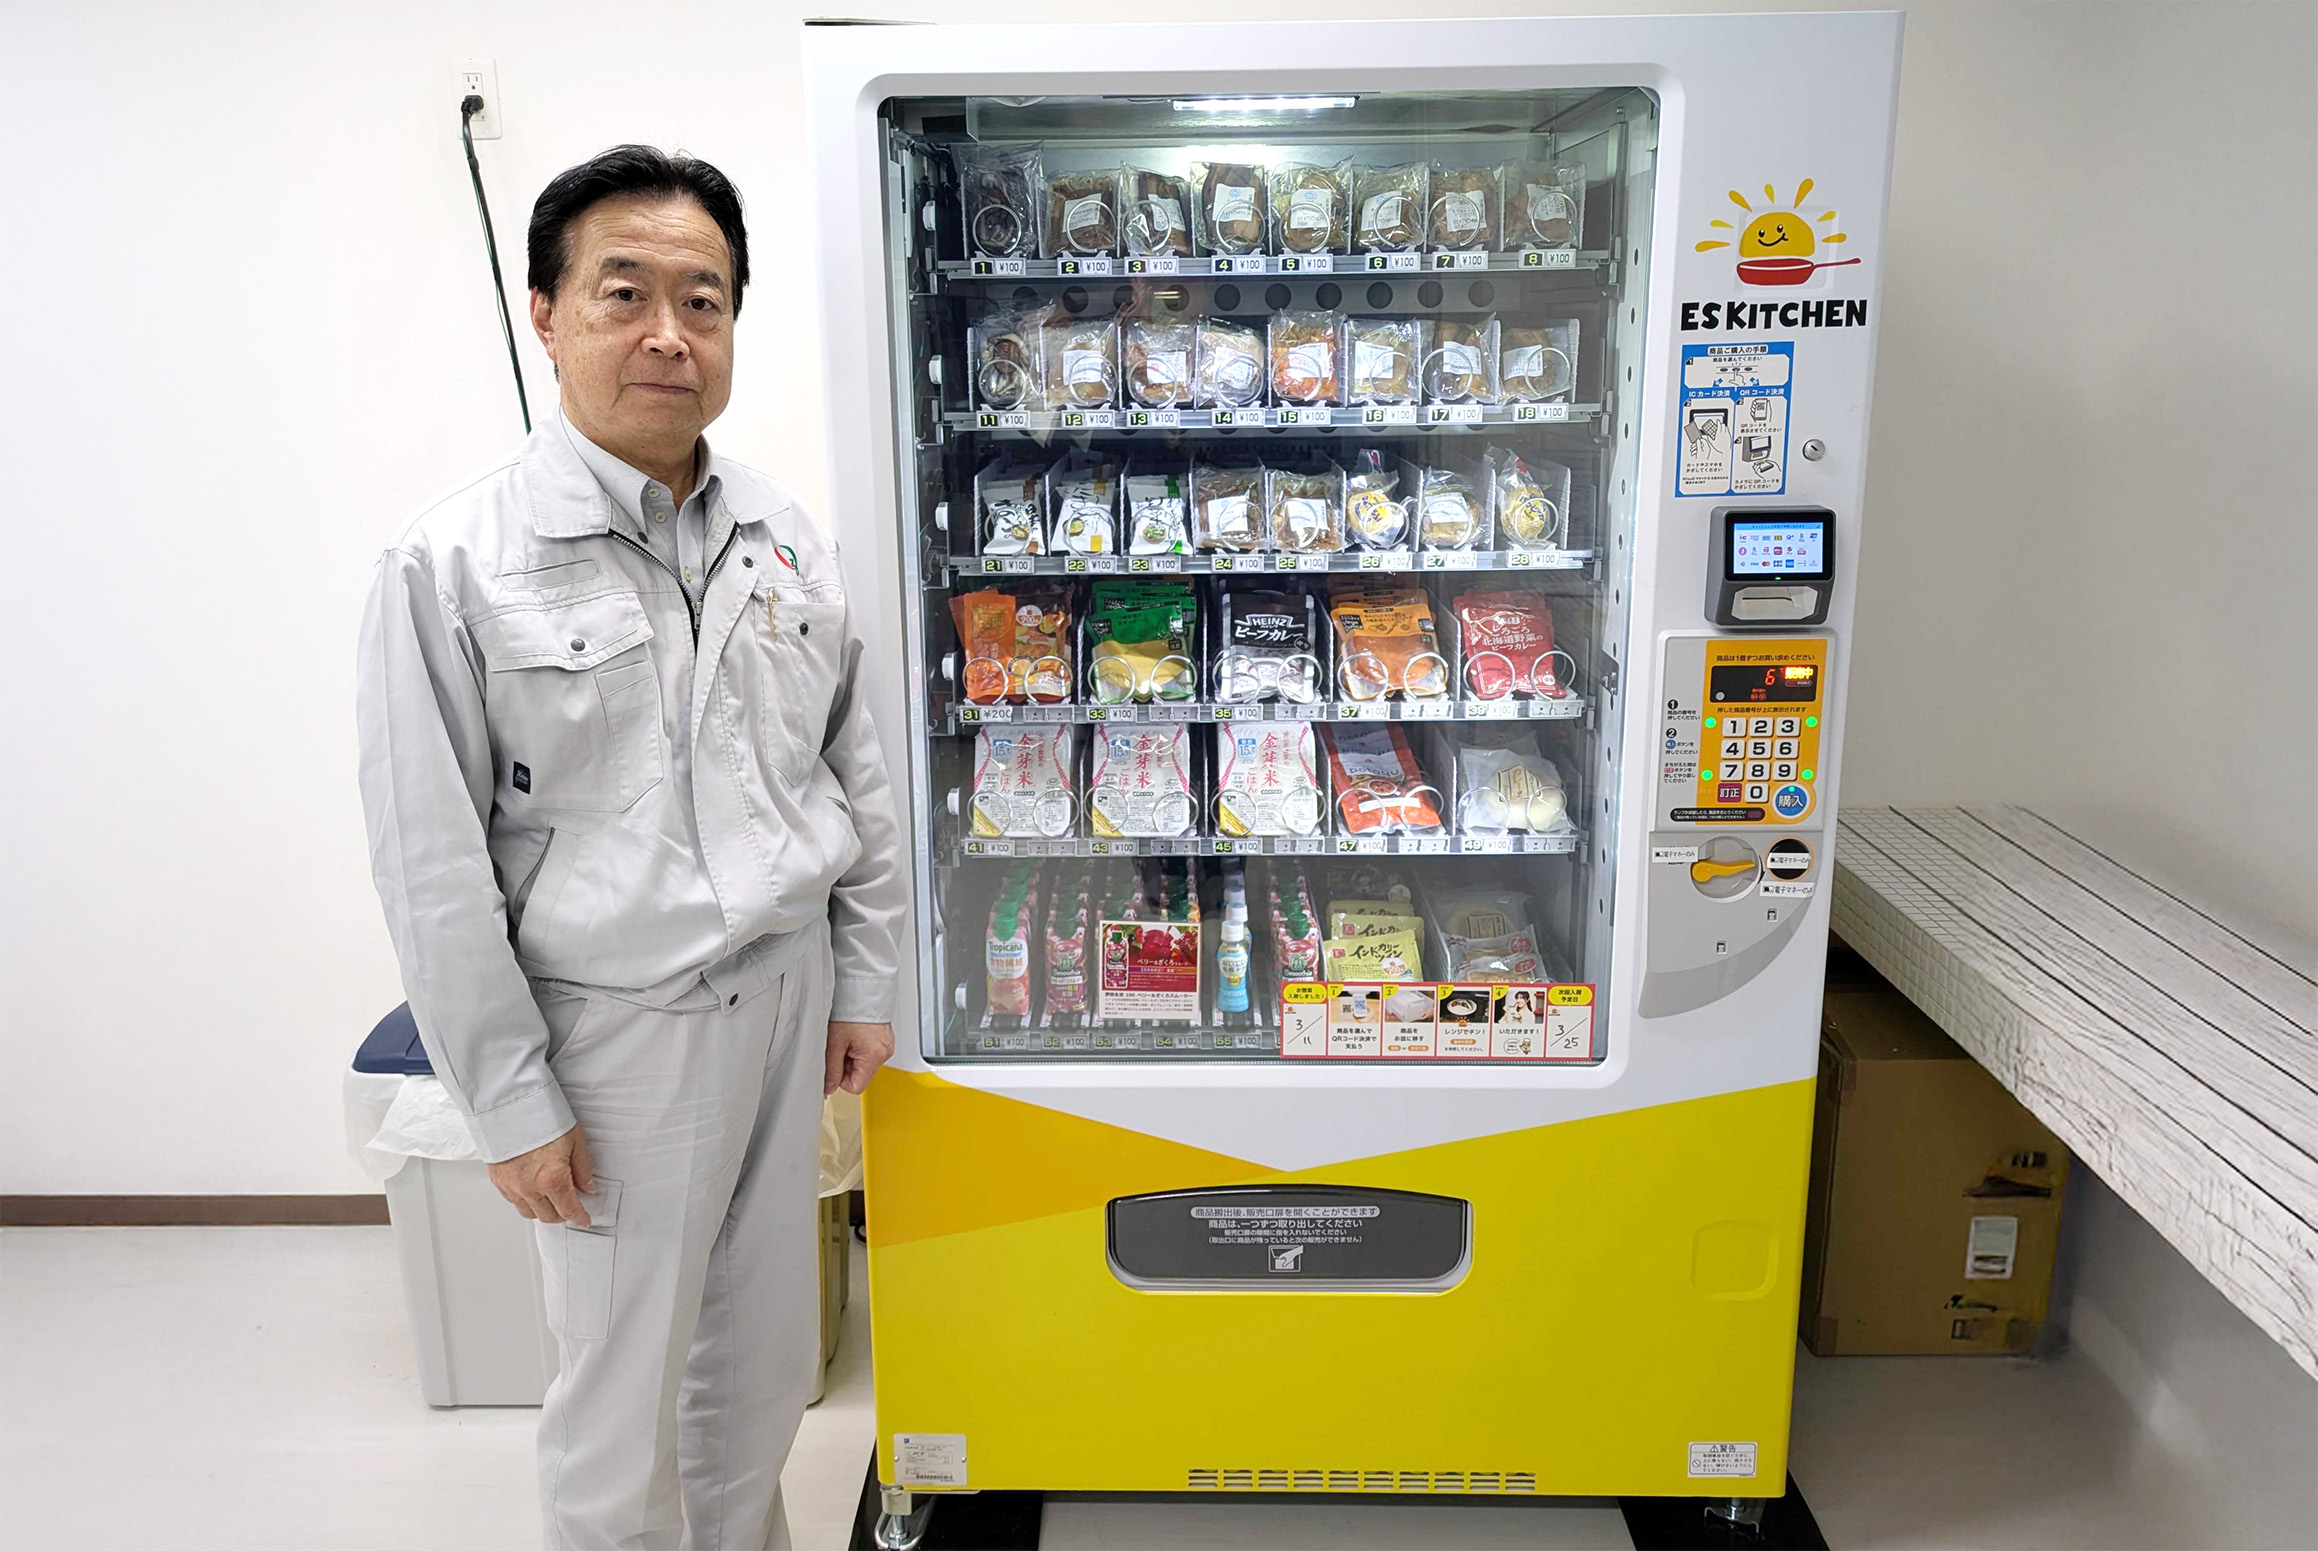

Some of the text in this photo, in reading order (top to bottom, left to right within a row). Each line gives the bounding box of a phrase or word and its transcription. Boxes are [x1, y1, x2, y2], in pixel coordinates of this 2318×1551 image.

[1286, 258, 1326, 269] 5 ¥100
[1373, 256, 1414, 268] 6 ¥100
[1441, 255, 1482, 267] 7 ¥100
[1528, 253, 1569, 265] 8 ¥100
[980, 261, 1019, 272] 1 ¥100
[1065, 261, 1106, 272] 2 ¥100
[1132, 261, 1173, 272] 3 ¥100
[1219, 260, 1260, 271] 4 ¥100
[1709, 346, 1767, 355] 商品ご購入の手順
[1216, 412, 1258, 423] 14 ¥100
[1282, 411, 1325, 422] 15 ¥100
[1367, 411, 1382, 421] 16
[1433, 408, 1476, 419] 17 ¥100
[1520, 407, 1562, 418] 18 ¥100
[982, 415, 1023, 426] 11 ¥100
[1067, 414, 1109, 426] 12 ¥100
[1131, 413, 1174, 424] 13 ¥100
[1133, 559, 1175, 570] 23 ¥100
[1216, 558, 1259, 569] 24 ¥100
[1280, 558, 1322, 568] 25 ¥100
[1363, 557, 1380, 568] 26
[1427, 556, 1444, 567] 27
[1512, 554, 1556, 565] 28 ¥100
[986, 560, 1028, 571] 21 ¥100
[1069, 560, 1111, 571] 22 ¥100
[1252, 617, 1288, 626] HEINZ
[1235, 626, 1304, 642] ビーフカレー
[1482, 633, 1544, 646] 北海道野菜の
[1491, 643, 1537, 651] ビーフカレー
[1717, 654, 1815, 662] 商品は1個ずつお買い求めください
[1765, 668, 1776, 686] 6
[964, 710, 1011, 720] 31 ¥200
[1090, 709, 1132, 720] 33 ¥100
[1215, 708, 1257, 719] 35 ¥100
[1342, 706, 1358, 717] 37
[1717, 706, 1807, 714] 押した商品番号が上に表示されます
[1730, 720, 1737, 734] 1
[1754, 720, 1768, 733] 2
[1781, 720, 1794, 734] 3
[1726, 742, 1739, 756] 4
[1753, 742, 1766, 756] 5
[1779, 742, 1792, 755] 6
[1725, 764, 1738, 778] 7
[1751, 764, 1765, 778] 8
[1778, 764, 1791, 778] 9
[1719, 788, 1740, 799] 訂正
[1750, 785, 1763, 799] 0
[1778, 794, 1804, 808] 購入
[969, 842, 1008, 853] 41 ¥100
[1092, 842, 1133, 853] 43 ¥100
[1216, 842, 1257, 851] 45 ¥100
[1341, 841, 1356, 852] 47
[1465, 841, 1481, 851] 49
[989, 940, 1023, 953] Tropicana
[1350, 943, 1400, 959] インドカリー
[1555, 1024, 1565, 1037] 3
[985, 1037, 1025, 1047] 51 ¥100
[1044, 1037, 1085, 1047] 52 ¥100
[1096, 1037, 1136, 1047] 53 ¥100
[1157, 1037, 1197, 1046] 54 ¥100
[1216, 1037, 1257, 1046] 55 ¥100
[1563, 1037, 1579, 1049] 25
[1195, 1207, 1377, 1217] 商品搬出後、販売口扉を開くことができます
[1209, 1220, 1363, 1229] 商品は、一つずつ取り出してください
